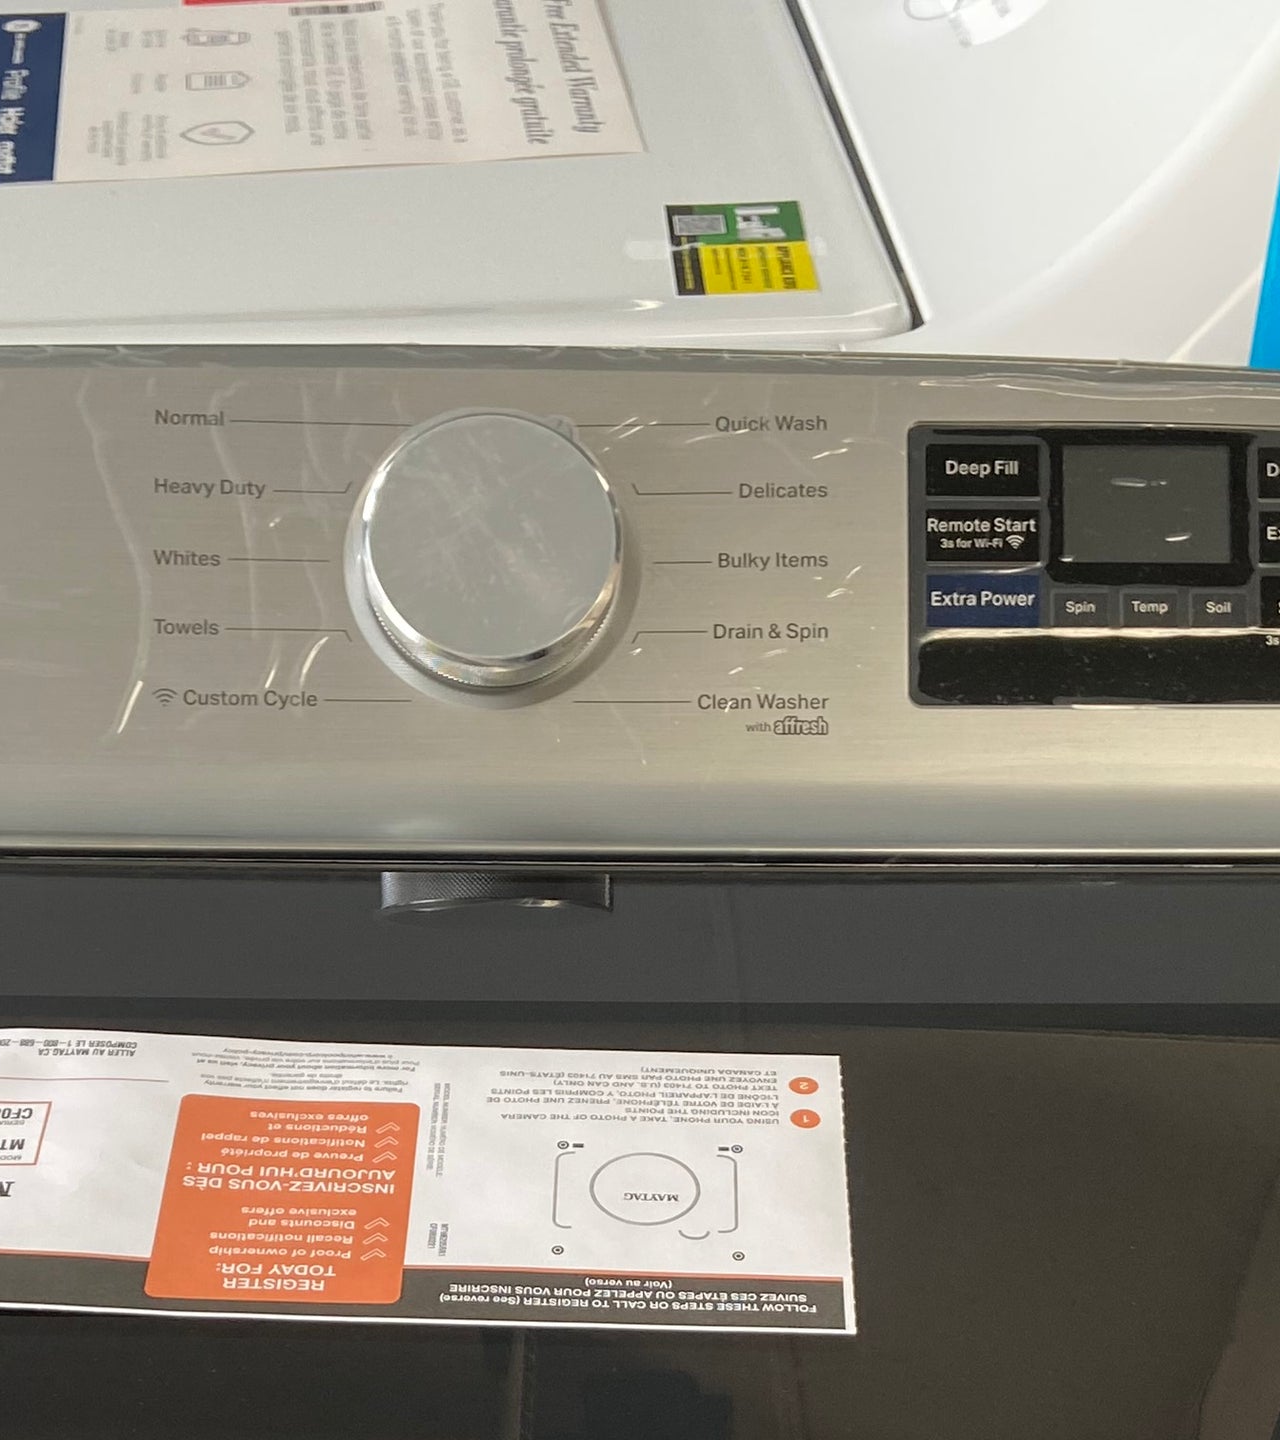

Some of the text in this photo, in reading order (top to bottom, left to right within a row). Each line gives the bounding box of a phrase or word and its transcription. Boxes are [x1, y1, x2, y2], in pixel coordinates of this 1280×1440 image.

[548, 22, 594, 73] Extended
[568, 76, 607, 133] Warranty
[509, 97, 554, 146] gratuite
[155, 409, 224, 426] Normal
[715, 415, 827, 432] Quick Wash
[946, 460, 1018, 478] Deep Fill
[154, 478, 266, 499] Heavy Duty
[739, 482, 828, 498] Delicates
[927, 517, 1037, 533] Remote Start
[940, 538, 1003, 548] 3s for Wi-Fi
[153, 549, 221, 566] Whites
[718, 552, 828, 571] Bulky Items
[931, 591, 1035, 606] Extra Power
[1066, 601, 1096, 615] Spin
[1131, 601, 1168, 614] Temp
[1206, 601, 1231, 613] Soil
[153, 619, 219, 635] Towels
[713, 623, 828, 642] Drain & Spin
[1266, 635, 1280, 645] 3s
[183, 689, 318, 710] Custom Cycle
[698, 694, 829, 710] Clean Washer
[745, 715, 829, 736] with affresh
[622, 1192, 681, 1203] MAYTAG
[208, 1245, 352, 1259] Proof of ownership
[215, 1262, 336, 1277] TODAY FOR:
[222, 1277, 325, 1292] REGISTER
